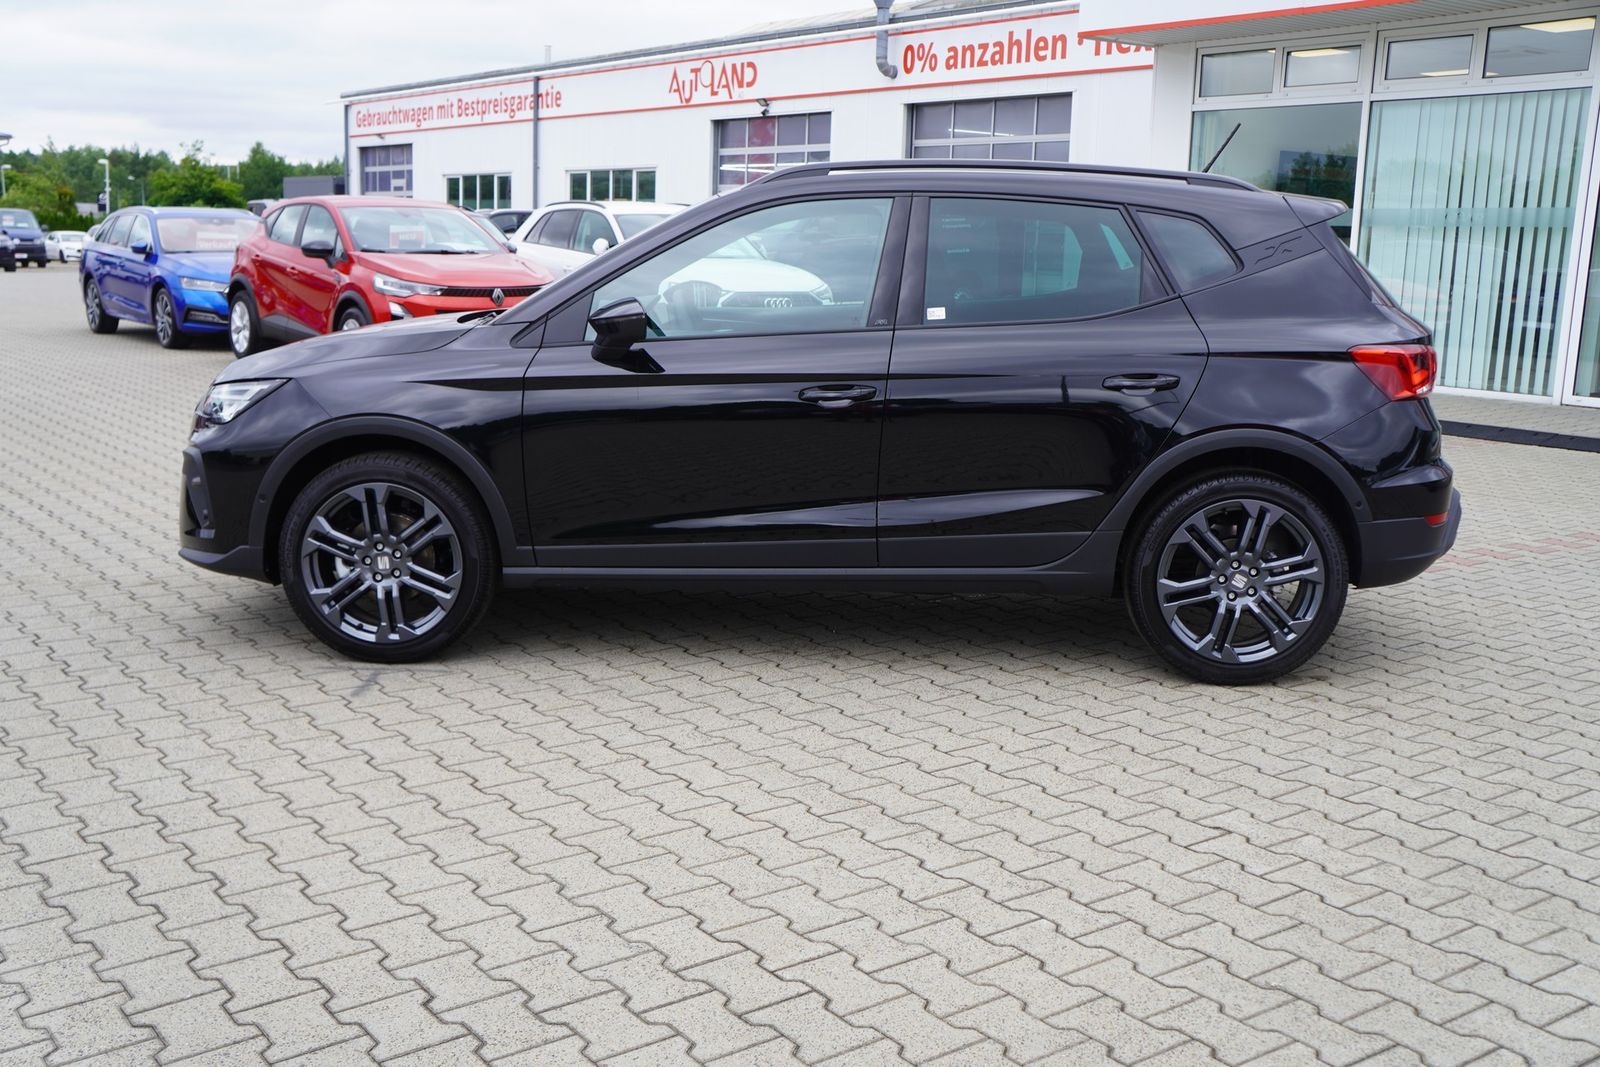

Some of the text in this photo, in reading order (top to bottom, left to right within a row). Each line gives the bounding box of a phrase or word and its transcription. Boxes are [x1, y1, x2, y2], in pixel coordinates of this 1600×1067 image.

[902, 41, 938, 75] 0%
[944, 29, 1068, 71] anzahlen
[668, 60, 758, 104] AUTOLAND
[356, 86, 562, 128] Gebrauchtwagen mit Bestpreisgarantie
